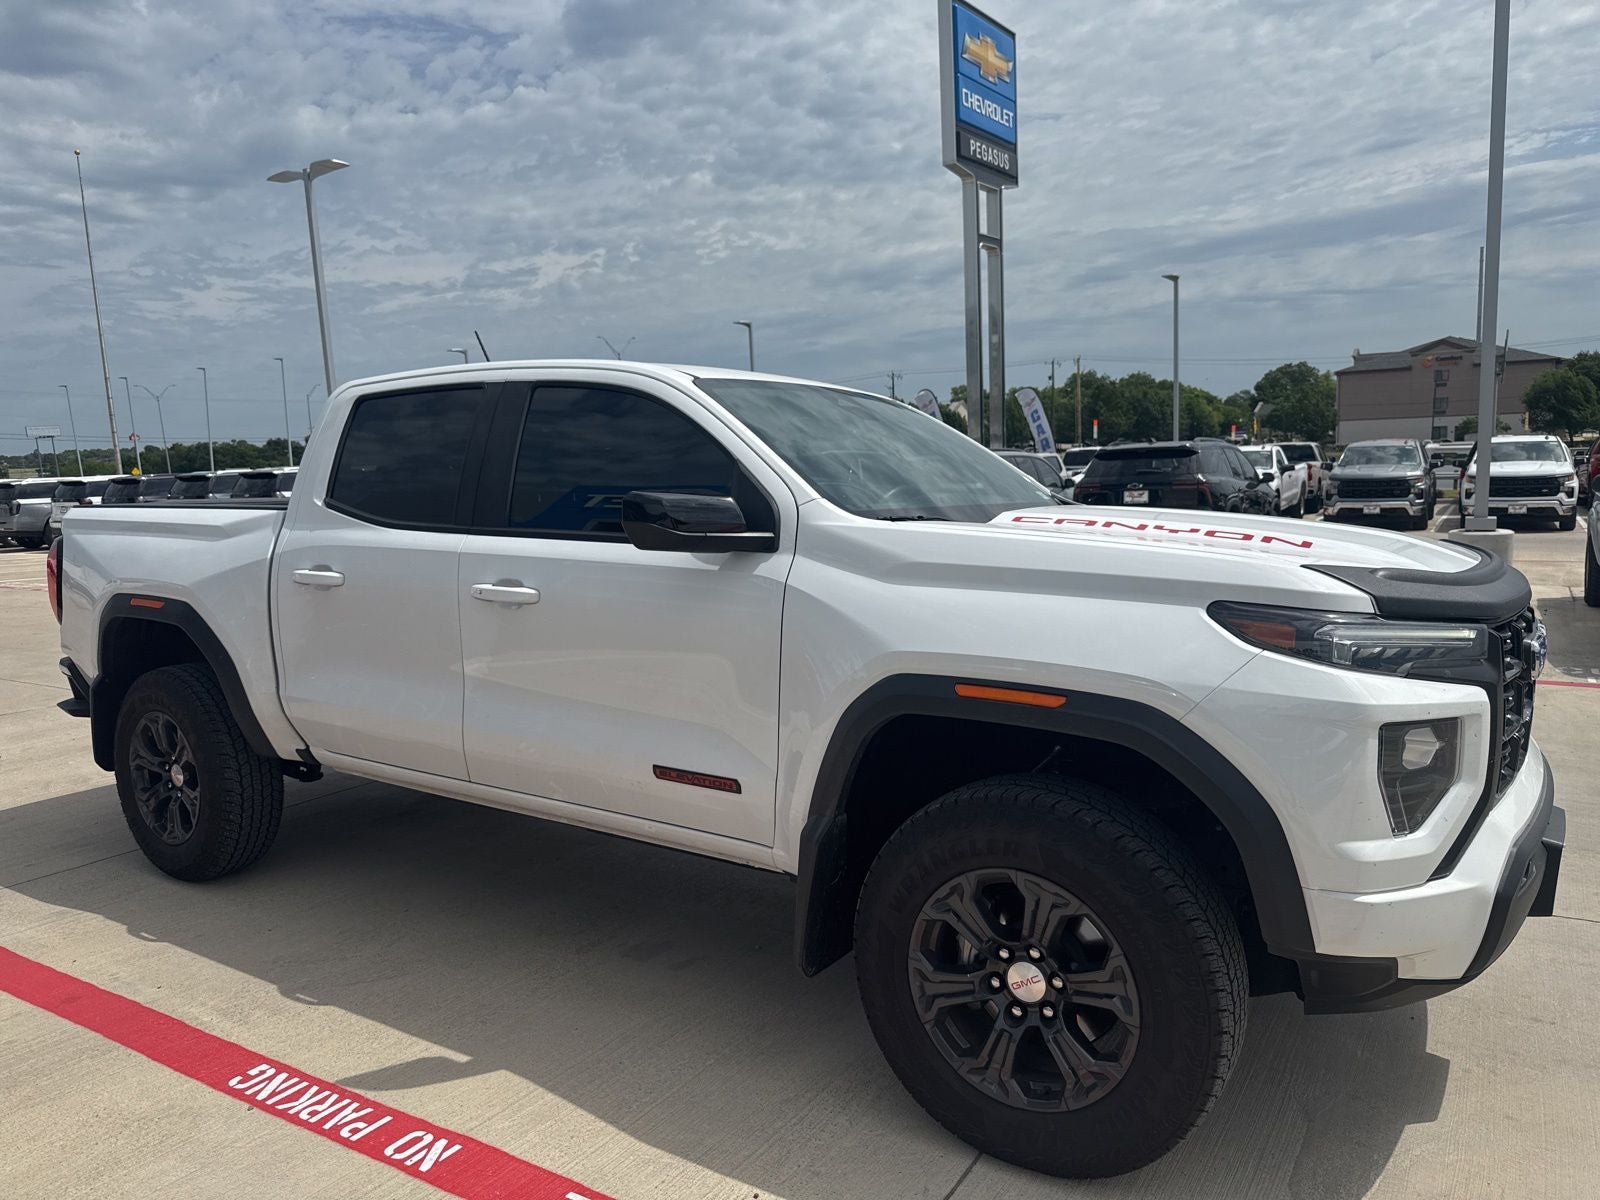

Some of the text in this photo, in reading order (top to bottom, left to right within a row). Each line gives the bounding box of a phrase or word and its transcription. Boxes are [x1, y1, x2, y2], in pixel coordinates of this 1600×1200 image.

[962, 88, 1014, 128] CHEVROLET
[969, 139, 1010, 170] PEGASUS
[1011, 516, 1313, 549] CANYON
[658, 769, 735, 790] ELEVATION
[1011, 974, 1041, 991] GMC
[227, 1063, 463, 1172] NO PARKING
